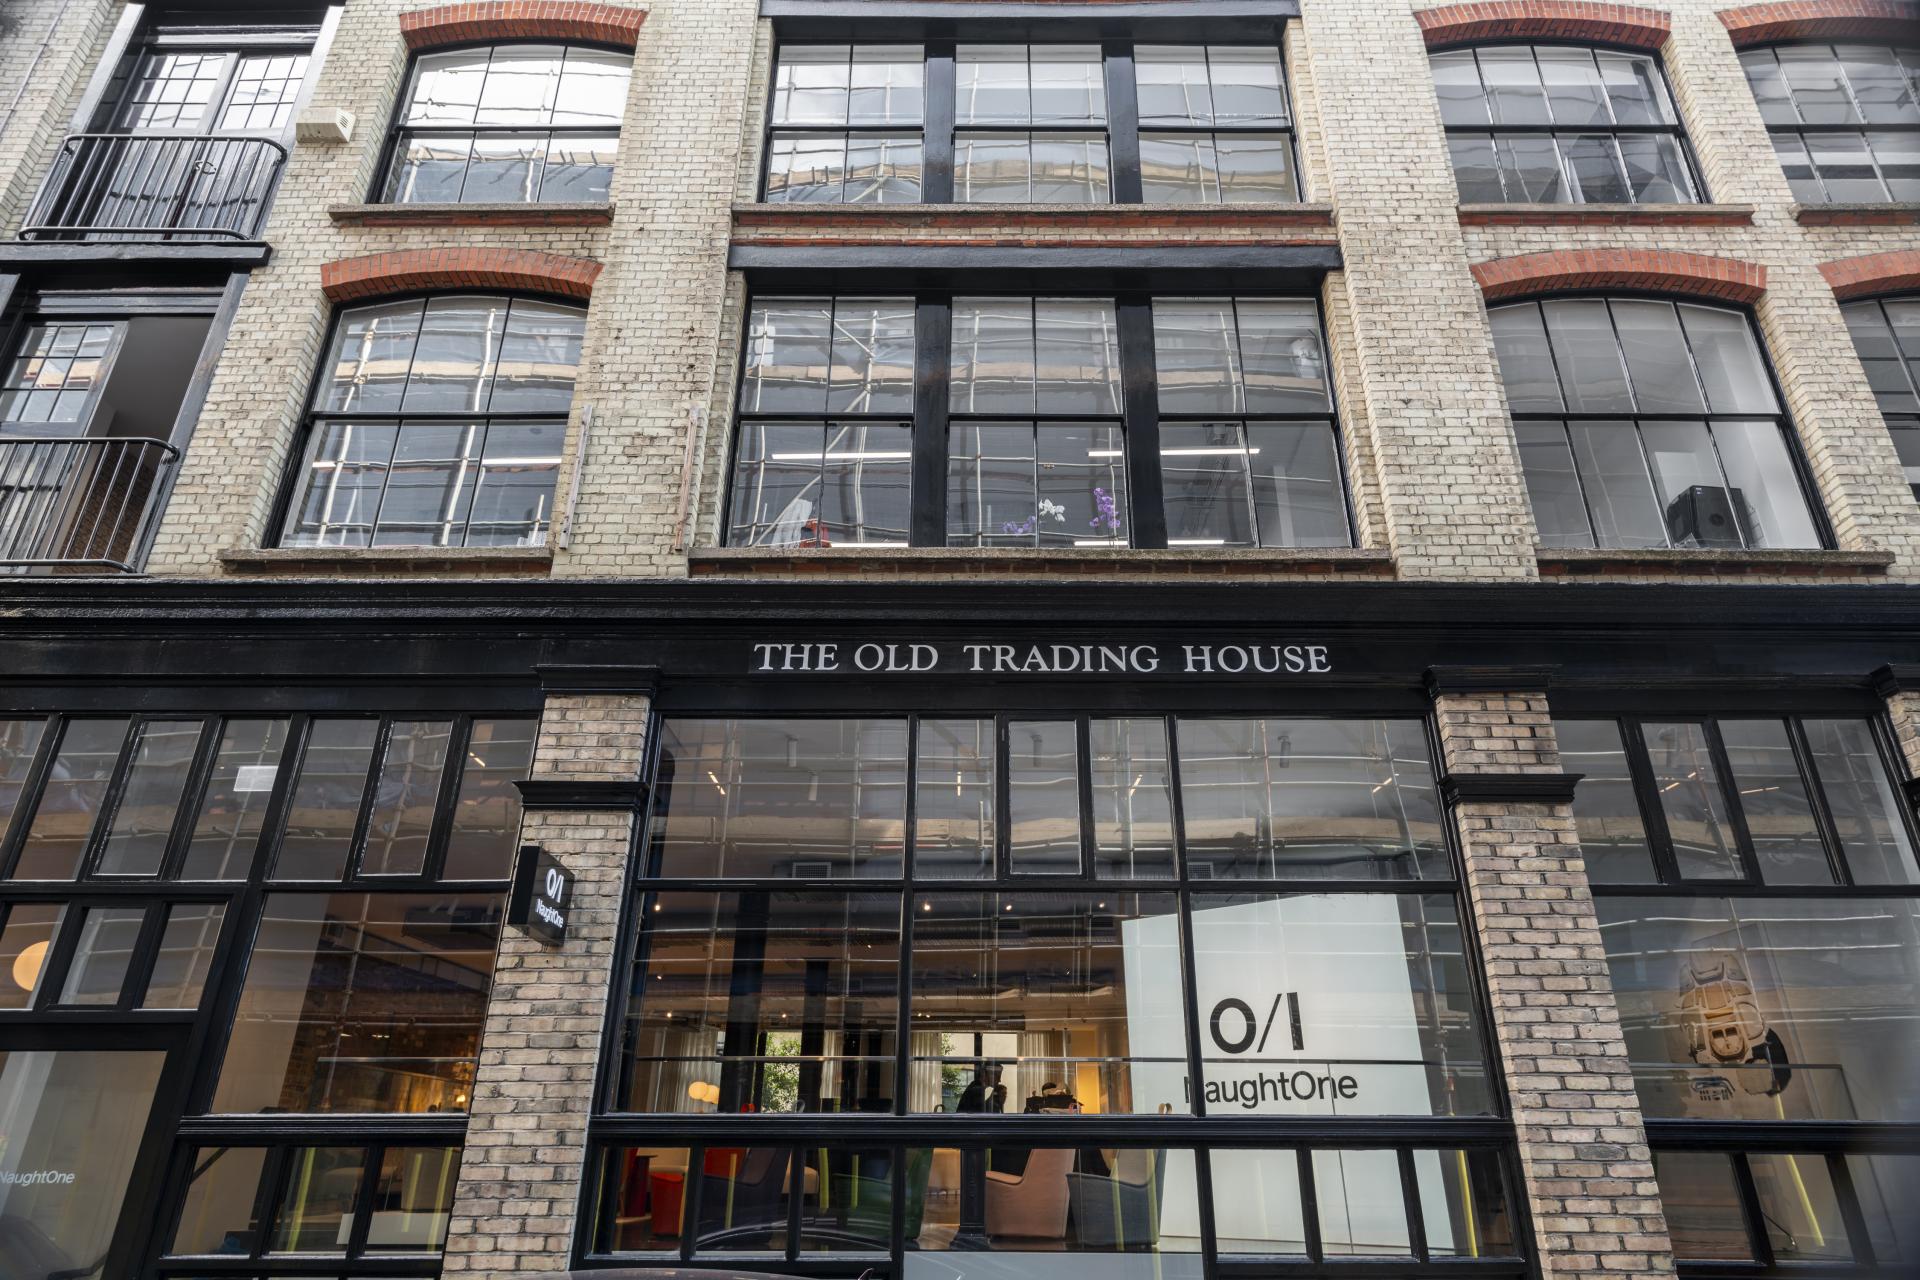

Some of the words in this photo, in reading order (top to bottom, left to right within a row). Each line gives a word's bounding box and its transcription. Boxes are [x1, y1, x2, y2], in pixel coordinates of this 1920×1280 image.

[753, 644, 838, 671] THE
[853, 643, 939, 671] OLD
[963, 645, 1160, 672] TRADING
[1183, 645, 1332, 673] HOUSE
[535, 898, 564, 928] NaughtOne
